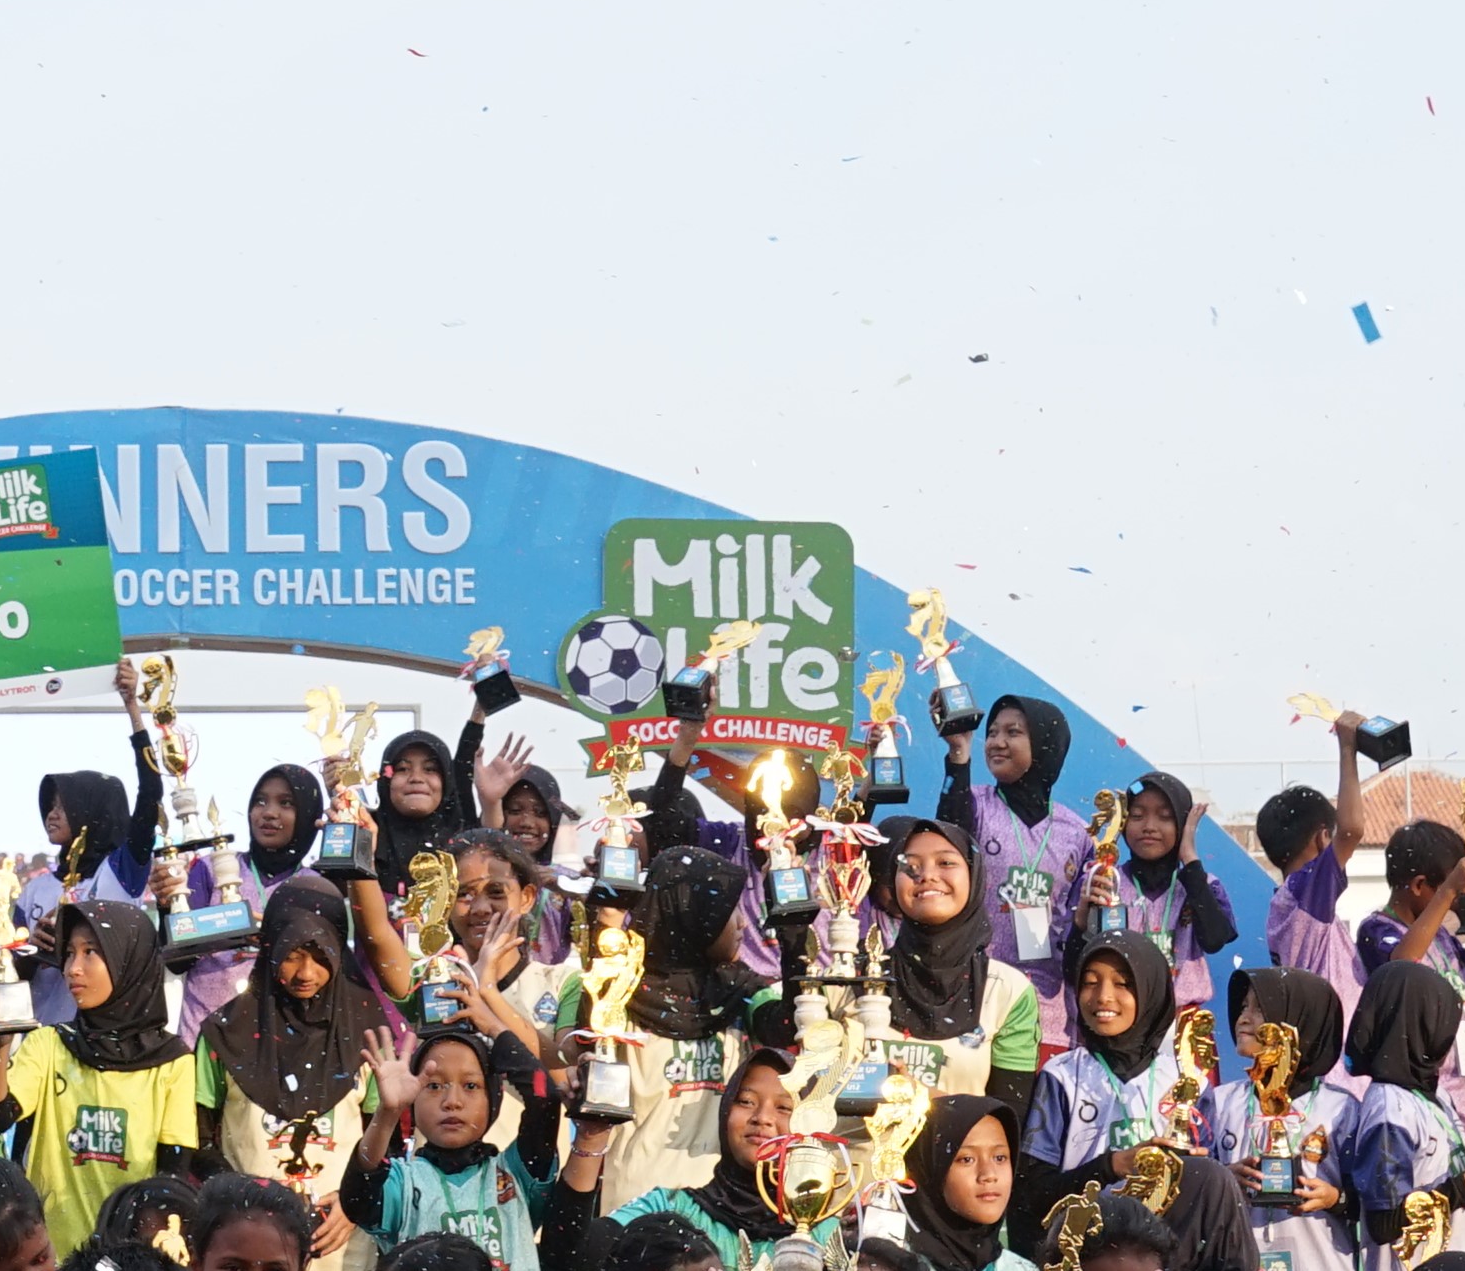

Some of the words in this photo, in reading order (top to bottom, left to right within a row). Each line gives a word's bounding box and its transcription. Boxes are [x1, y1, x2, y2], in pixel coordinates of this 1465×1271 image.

[114, 568, 239, 606] OCCER
[254, 568, 476, 605] CHALLENGE
[633, 533, 833, 624] Milk
[627, 718, 708, 742] SOCC
[713, 718, 832, 747] CHALLENGE
[680, 1039, 720, 1060] Milk
[890, 1045, 935, 1067] Milk
[686, 1058, 722, 1081] Life
[81, 1110, 123, 1131] Milk
[88, 1131, 123, 1153] Life
[472, 1234, 501, 1258] ife
